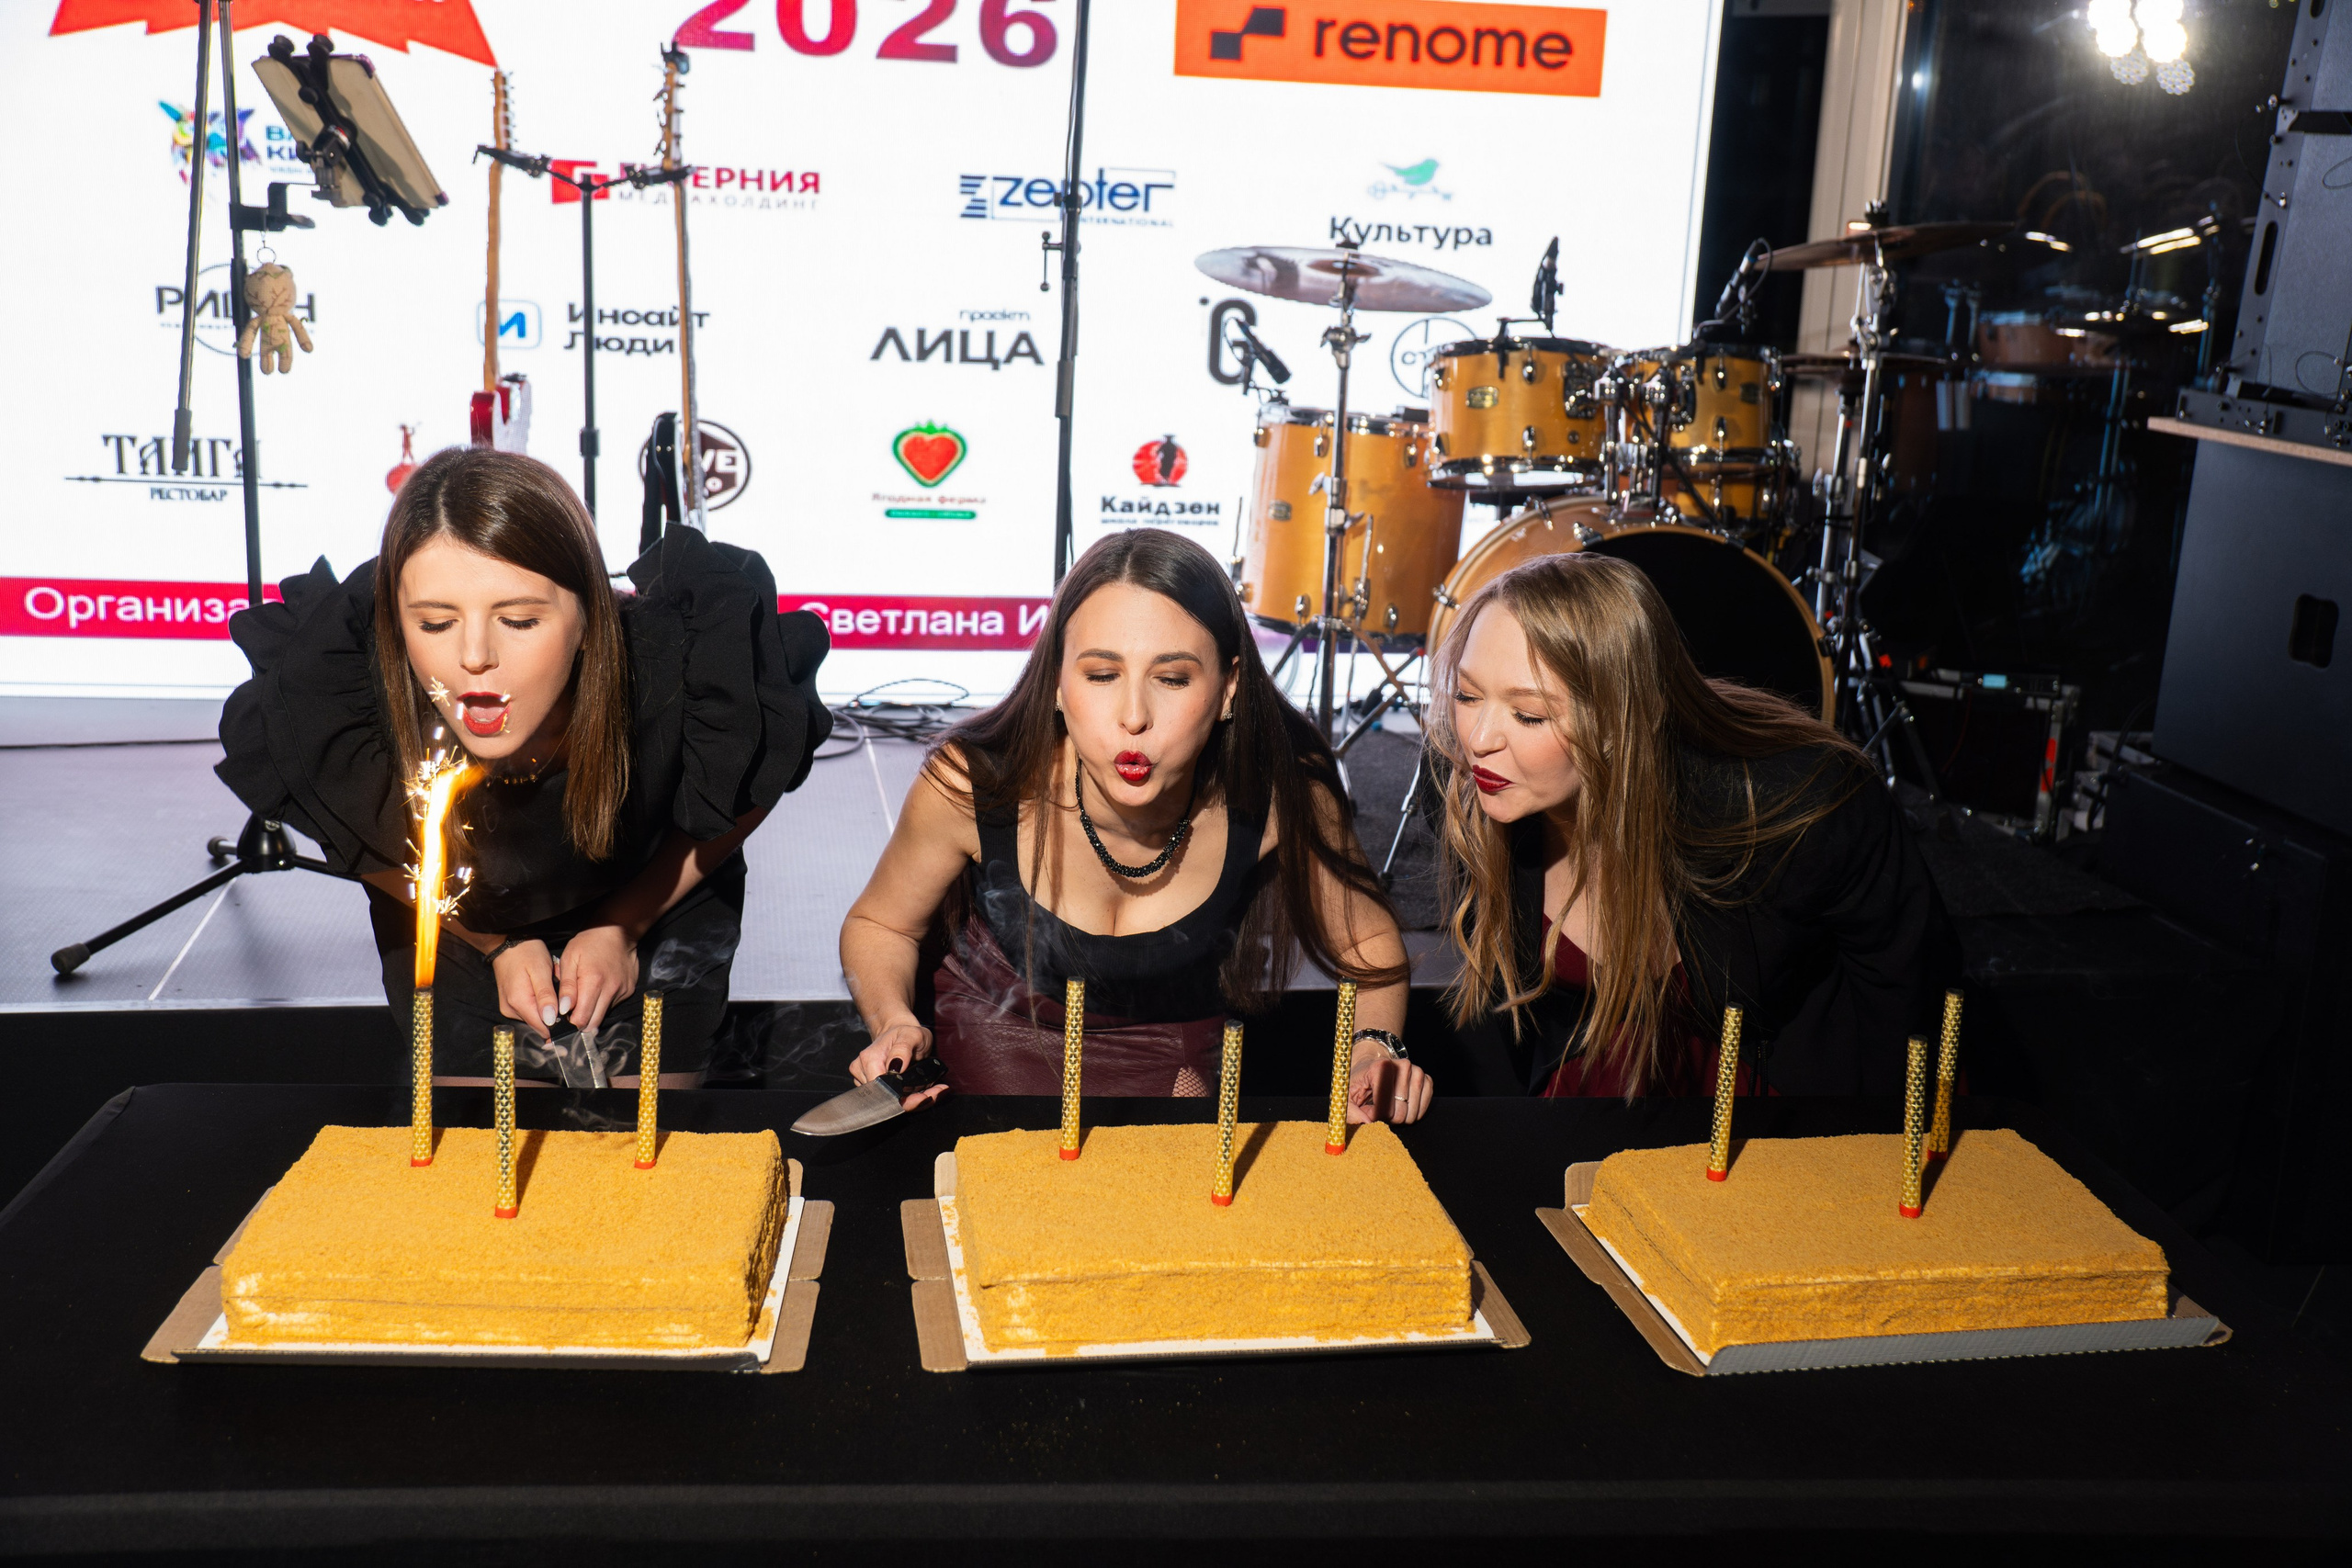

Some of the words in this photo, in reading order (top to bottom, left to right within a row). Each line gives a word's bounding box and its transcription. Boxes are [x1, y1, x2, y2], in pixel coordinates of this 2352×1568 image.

[673, 0, 1058, 68] 2026
[1315, 19, 1573, 69] renome
[619, 162, 820, 195] ГЕРНИЯ
[1329, 216, 1492, 250] Культура
[563, 331, 674, 356] Люди
[870, 326, 1045, 371] ЛИЦА
[150, 487, 228, 502] РЕСТОБАР
